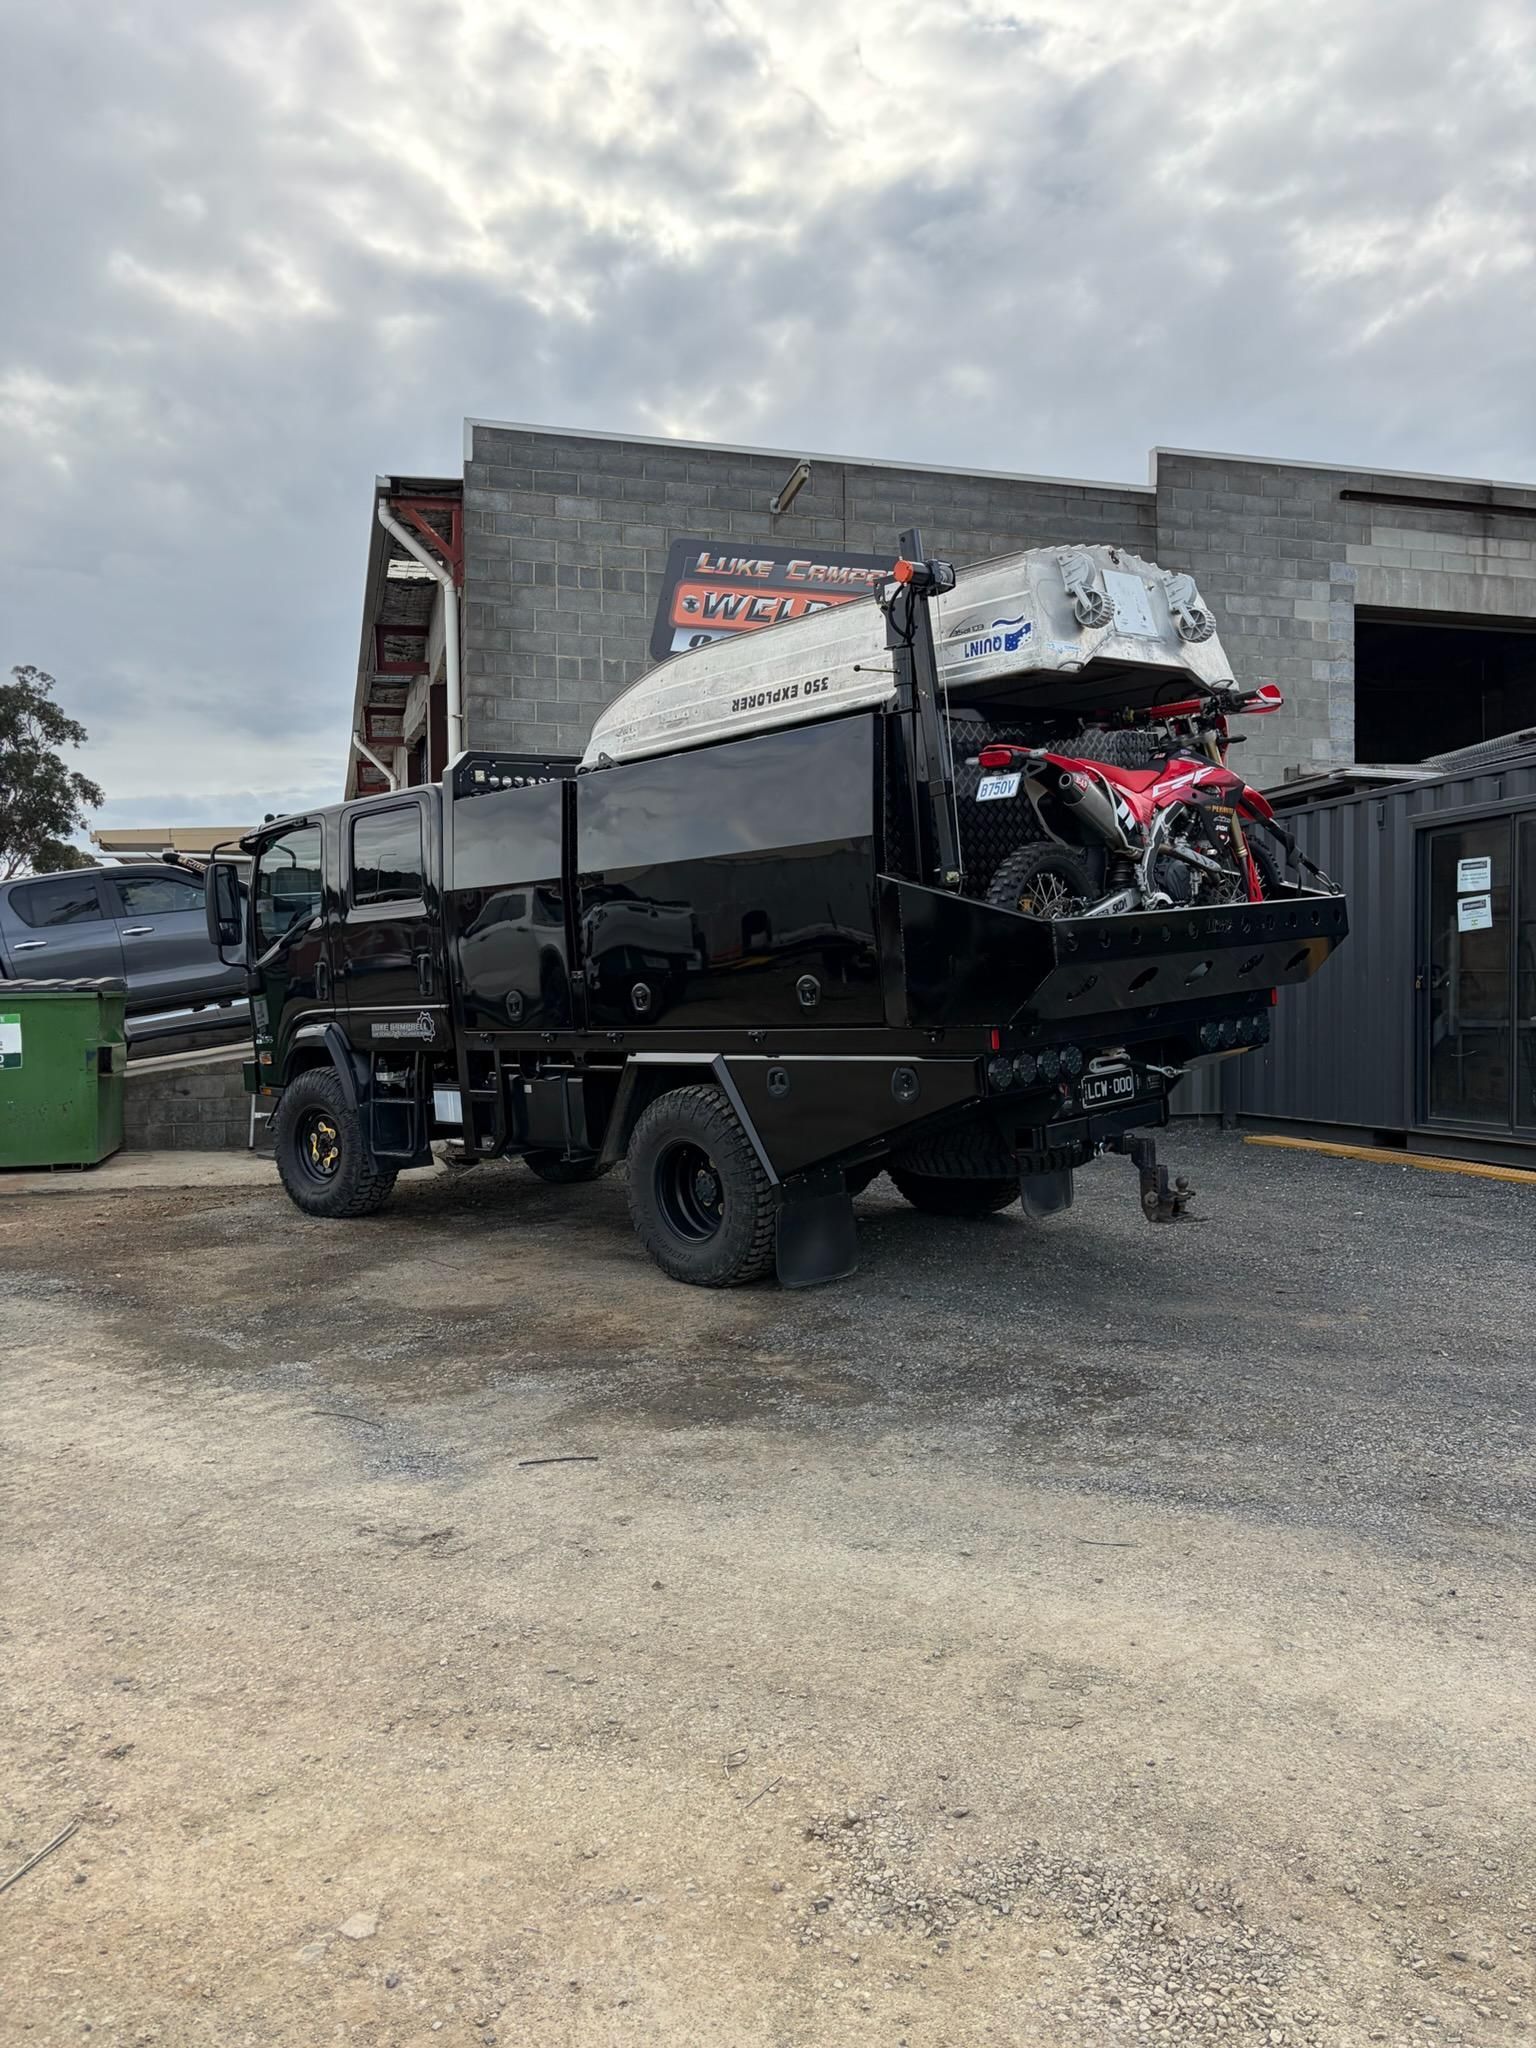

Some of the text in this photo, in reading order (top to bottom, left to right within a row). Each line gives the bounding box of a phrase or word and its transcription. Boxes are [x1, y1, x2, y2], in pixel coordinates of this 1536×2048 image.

[694, 552, 894, 587] LUKE CAMPB
[732, 677, 829, 712] 350 EXPLORER
[980, 780, 1015, 798] B750V
